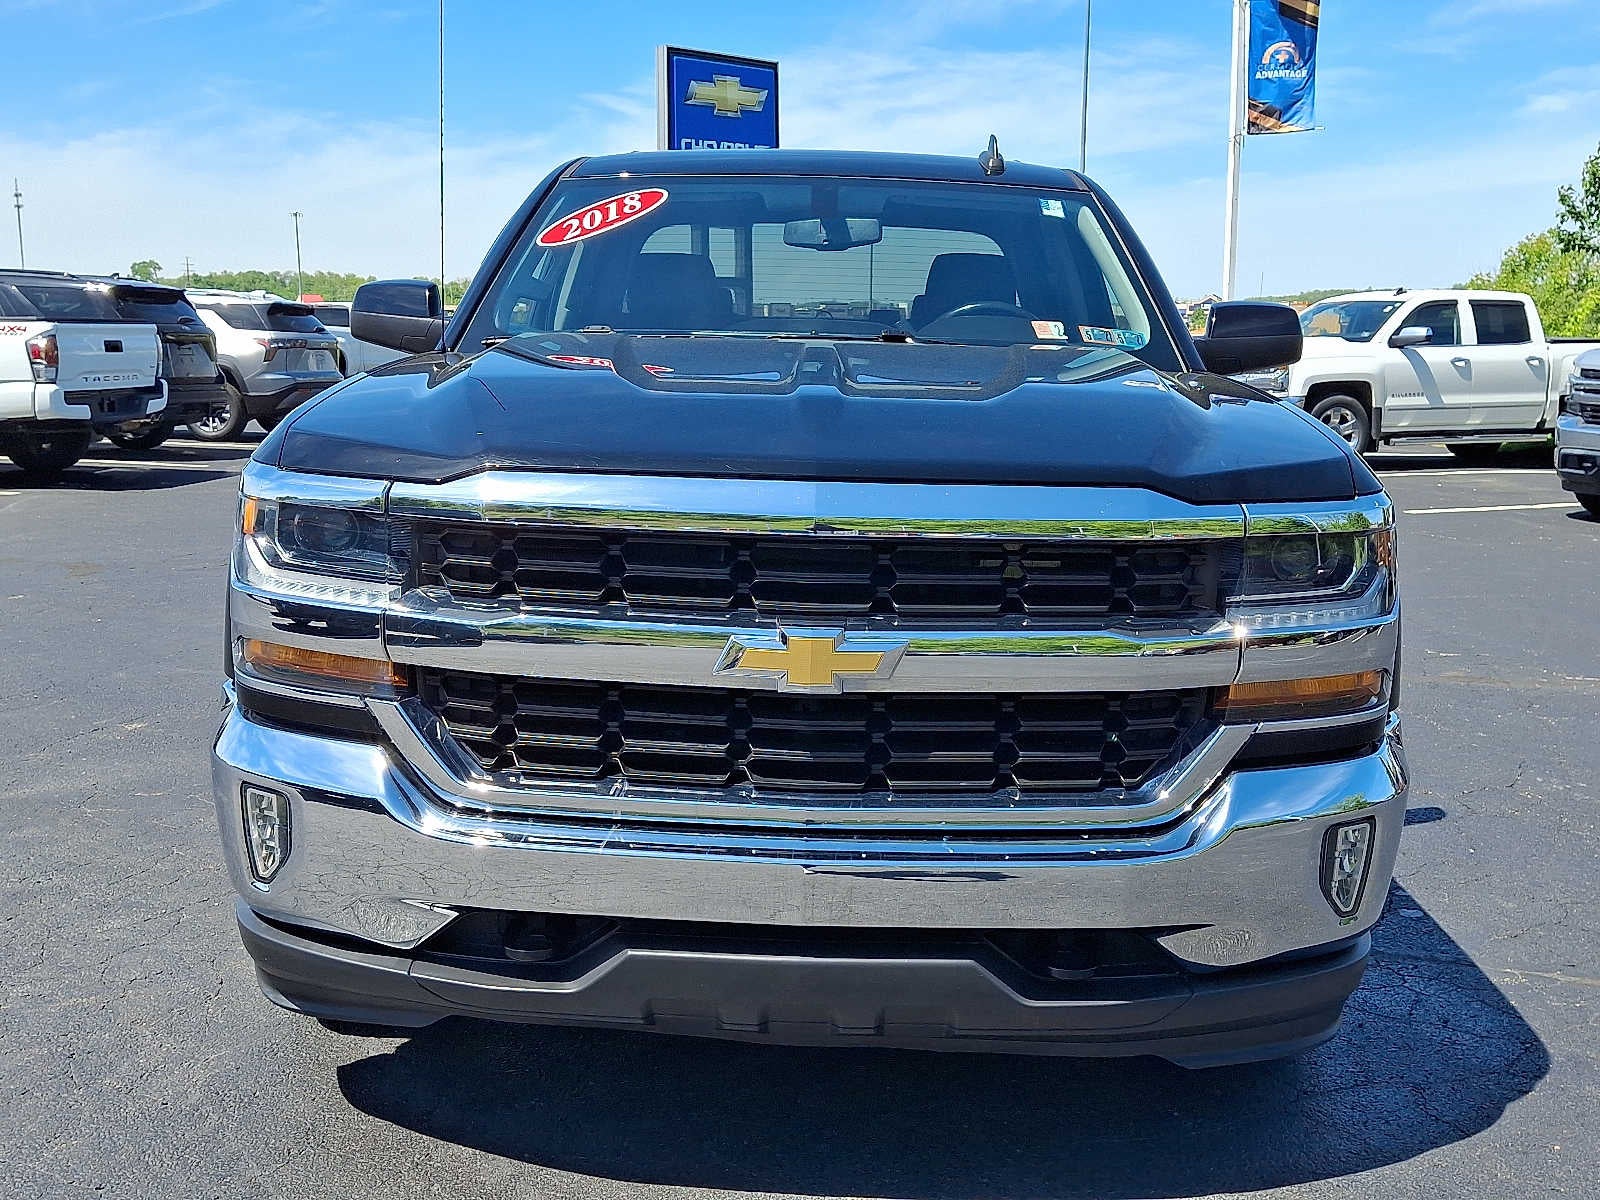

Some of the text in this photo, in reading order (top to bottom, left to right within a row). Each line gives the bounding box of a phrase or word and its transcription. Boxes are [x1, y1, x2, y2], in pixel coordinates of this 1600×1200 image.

[1255, 69, 1308, 79] ADVANTAGE
[562, 193, 642, 240] 2018
[82, 374, 138, 383] TACOMA
